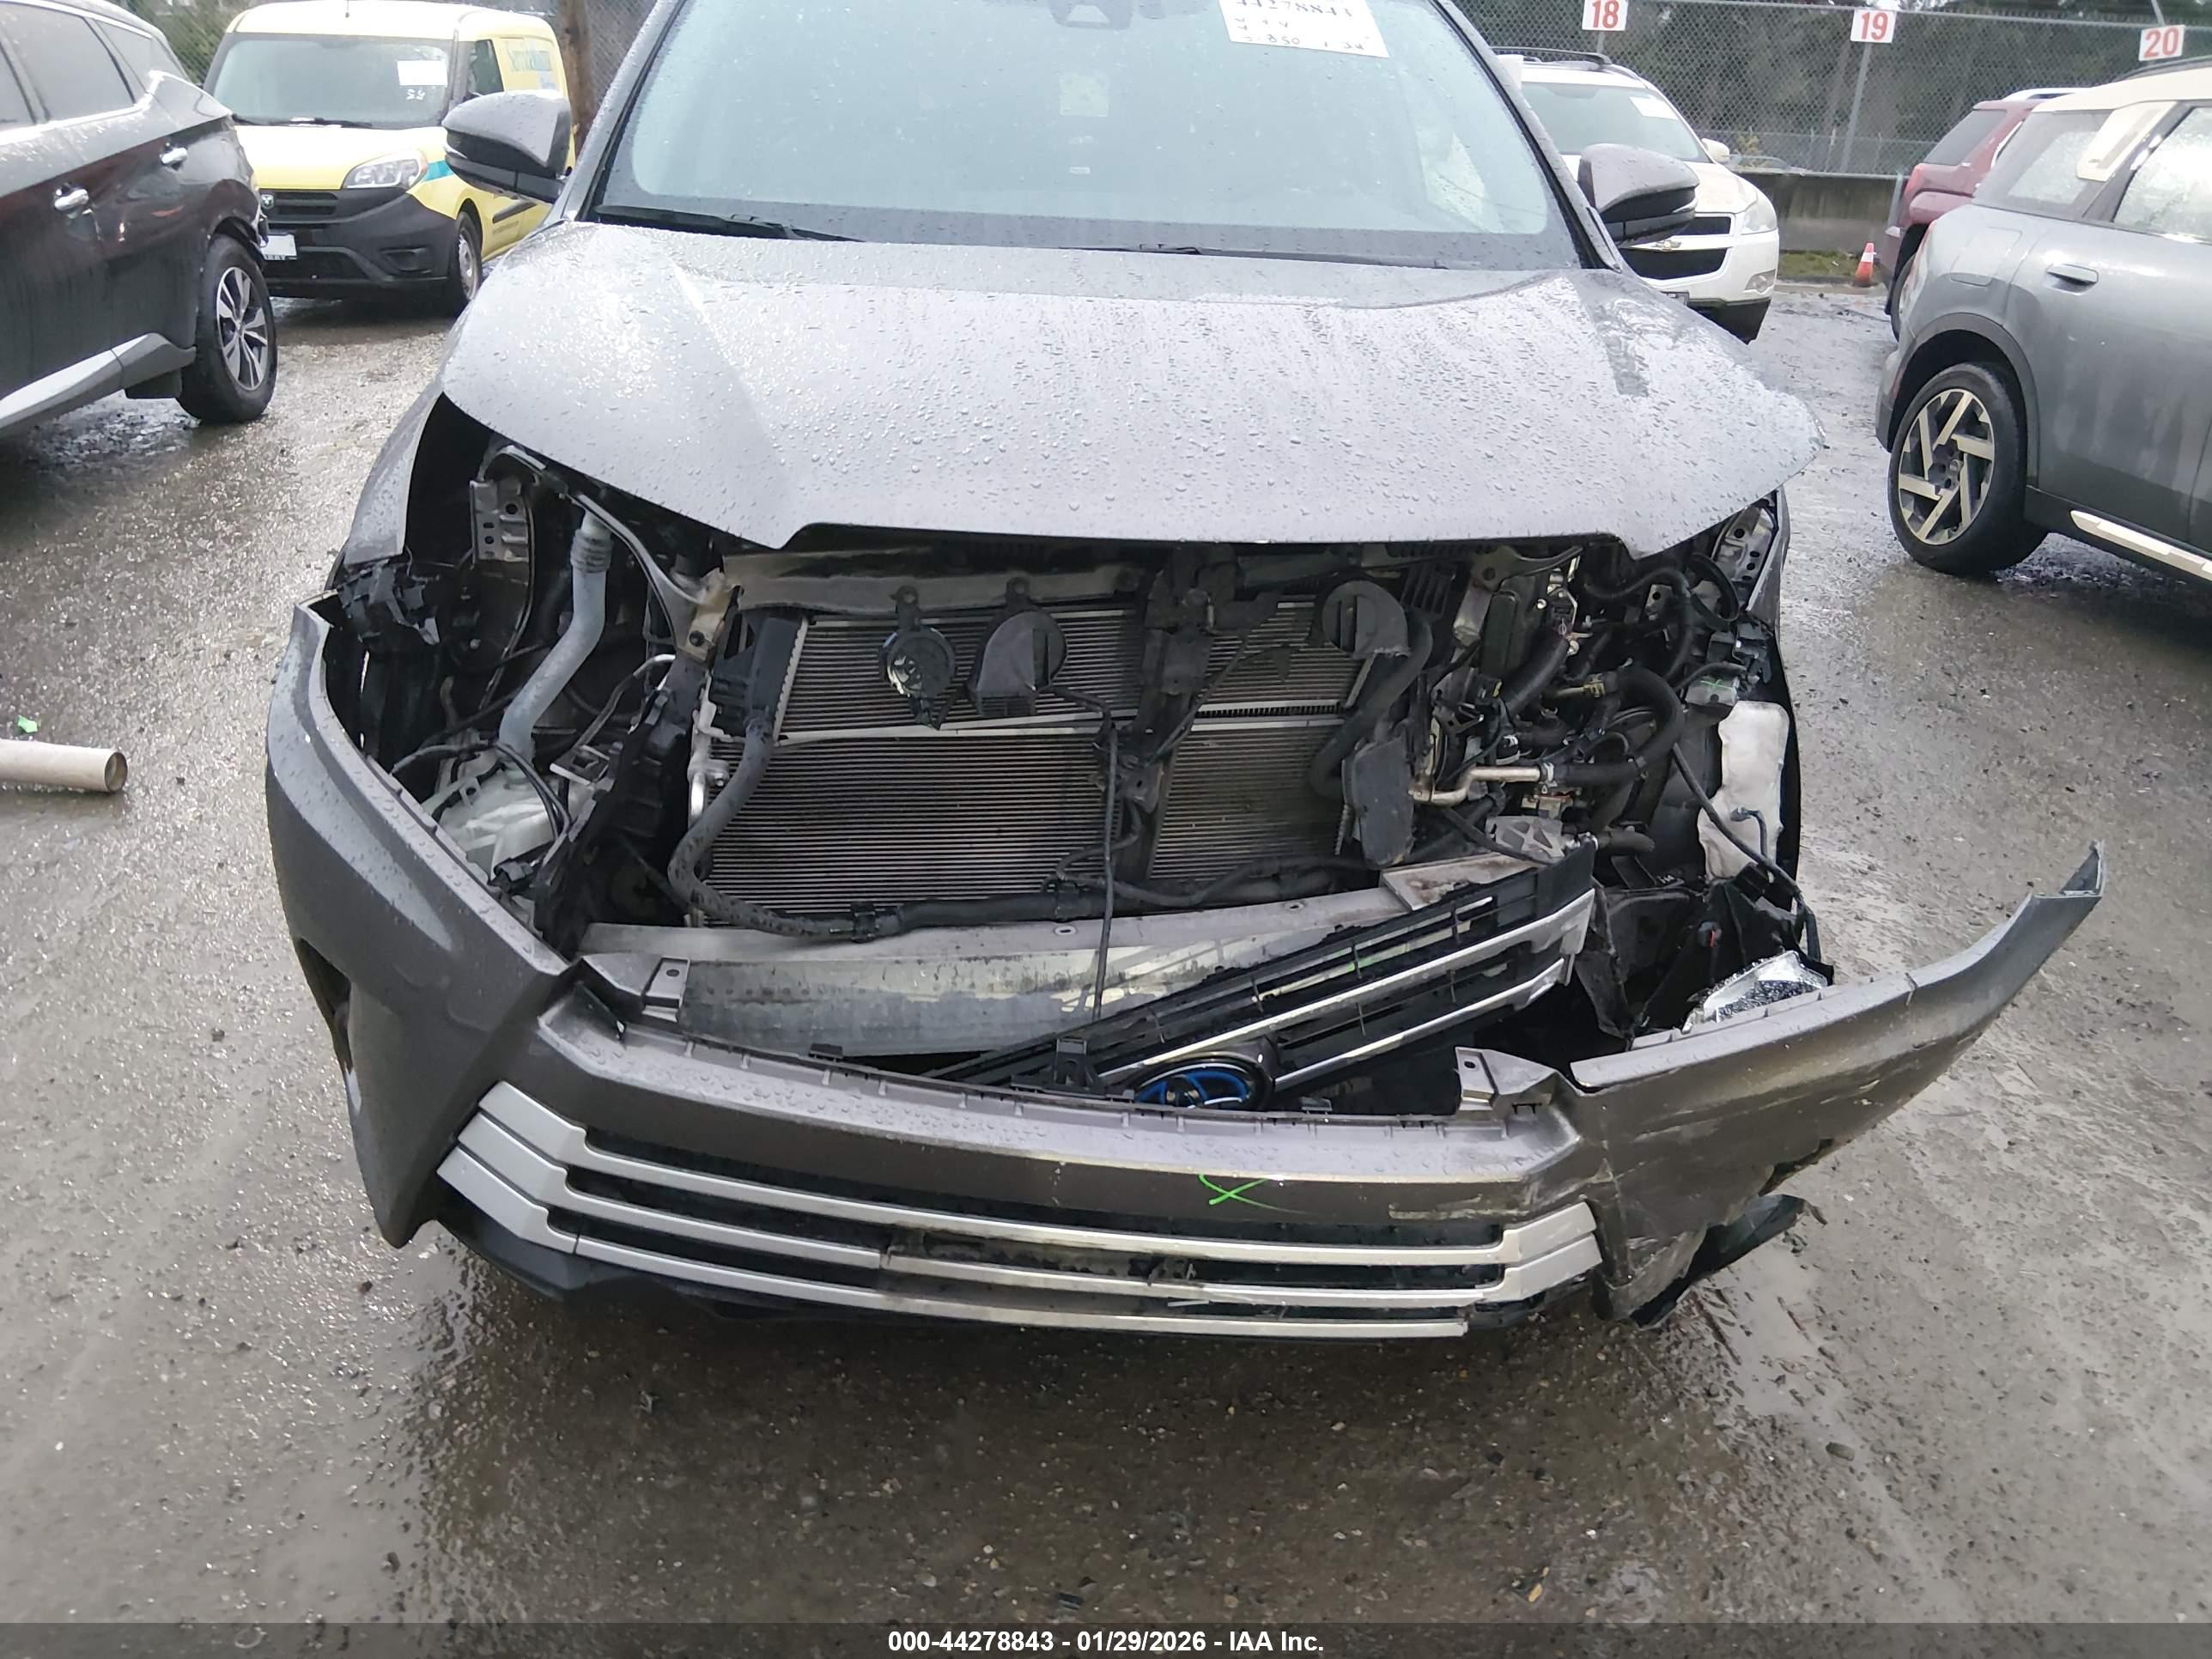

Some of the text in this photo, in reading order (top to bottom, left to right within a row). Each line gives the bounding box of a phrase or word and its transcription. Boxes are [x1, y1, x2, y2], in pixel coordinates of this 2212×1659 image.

[1592, 0, 1620, 28] 18
[1861, 12, 1888, 40] 19
[2143, 27, 2179, 58] 20
